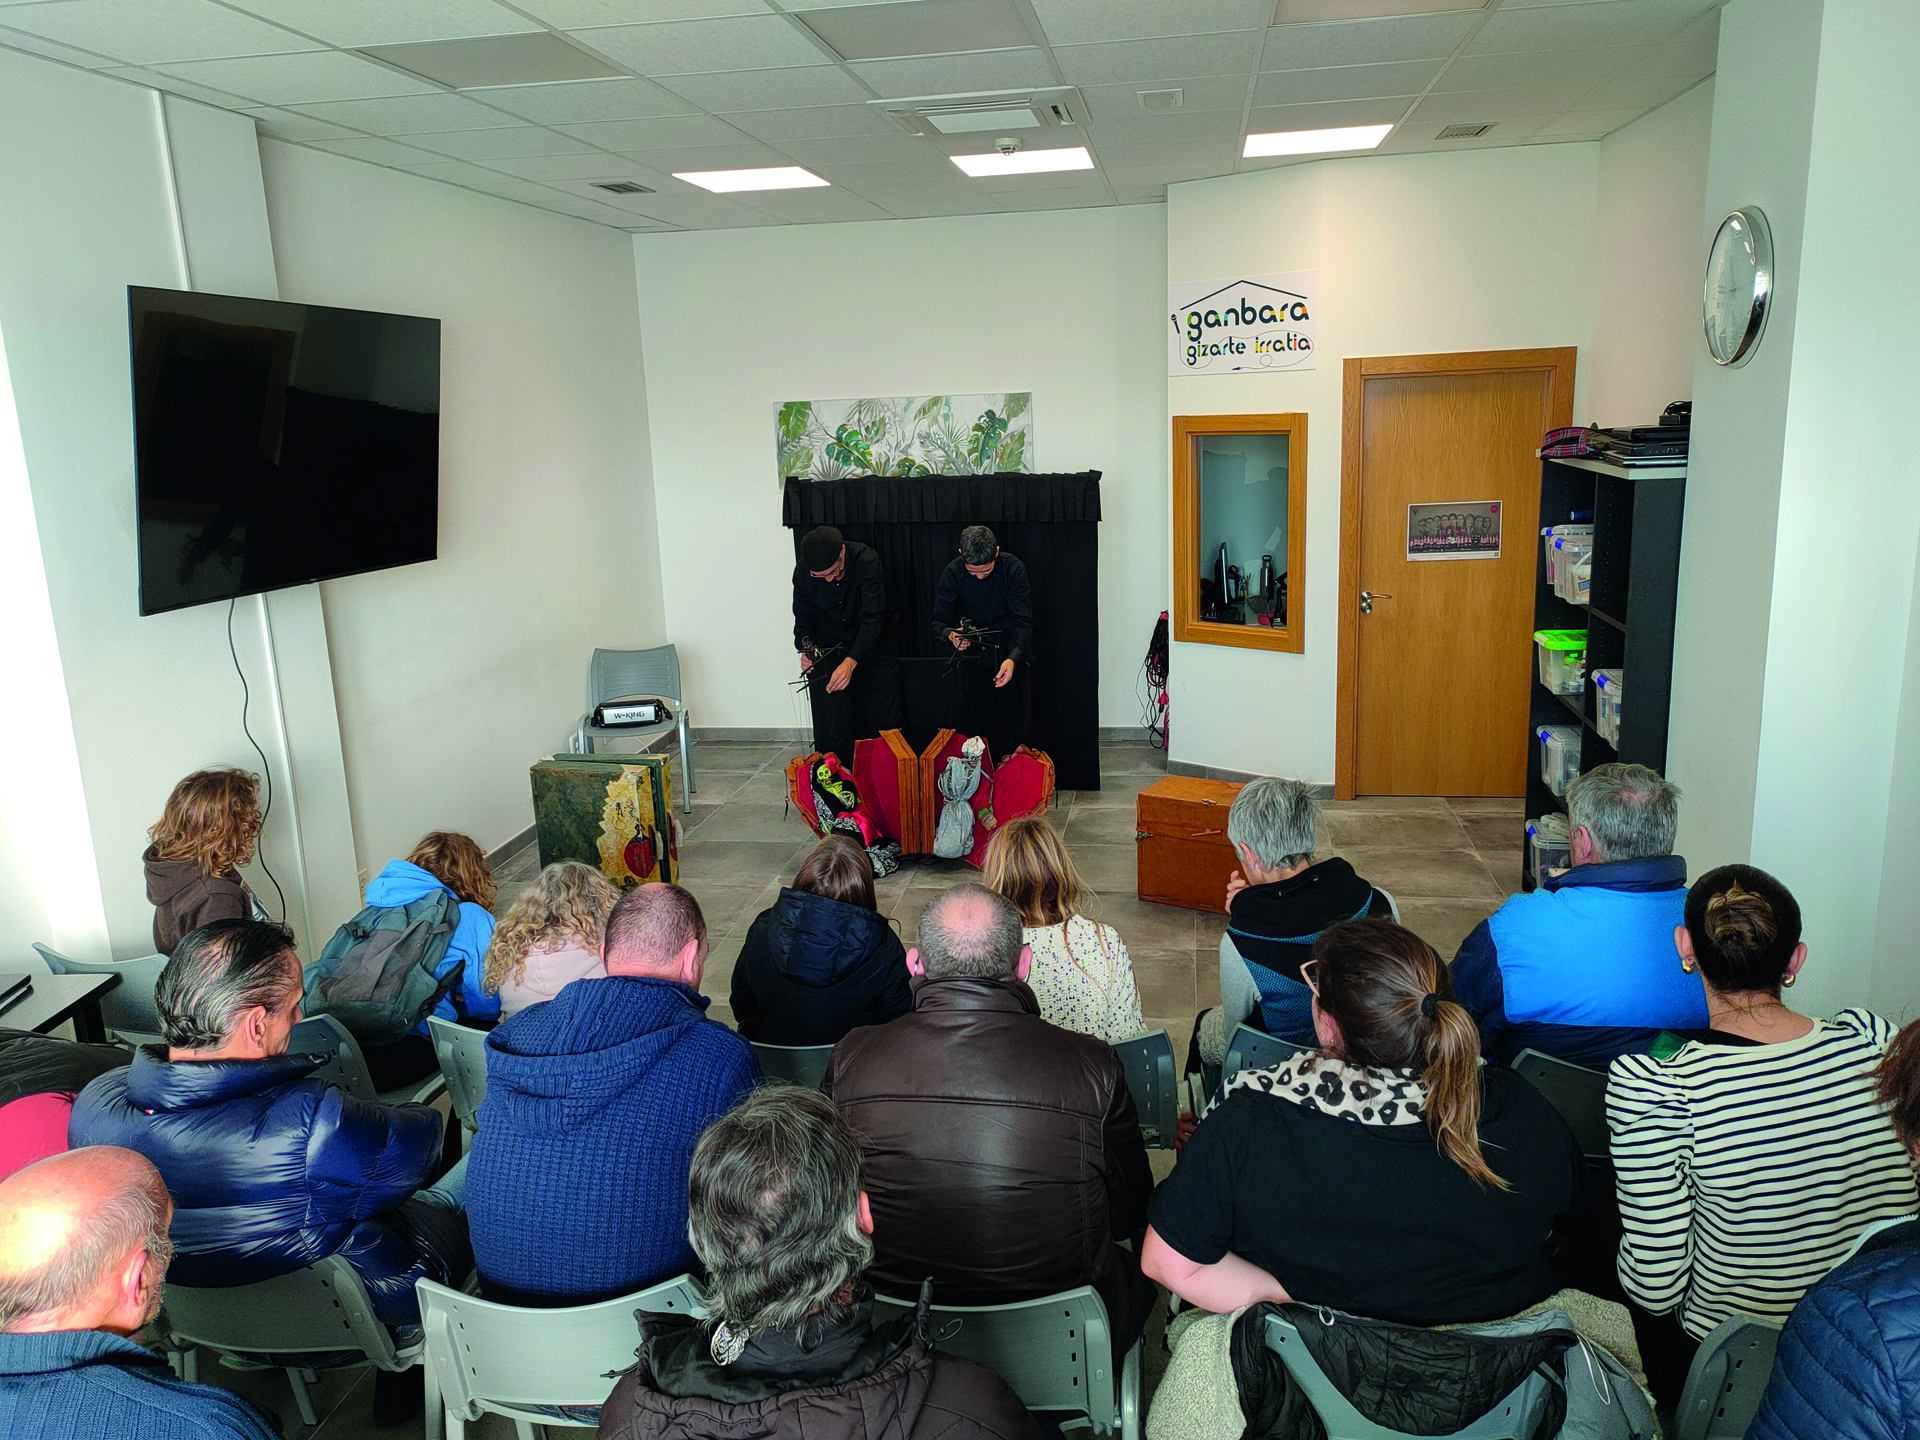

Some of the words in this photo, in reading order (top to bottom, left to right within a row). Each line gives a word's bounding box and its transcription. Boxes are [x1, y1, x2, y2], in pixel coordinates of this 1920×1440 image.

[1187, 297, 1310, 342] ganbara
[1186, 336, 1246, 366] gizarte
[1255, 332, 1311, 353] irratia
[613, 711, 645, 719] W-KING
